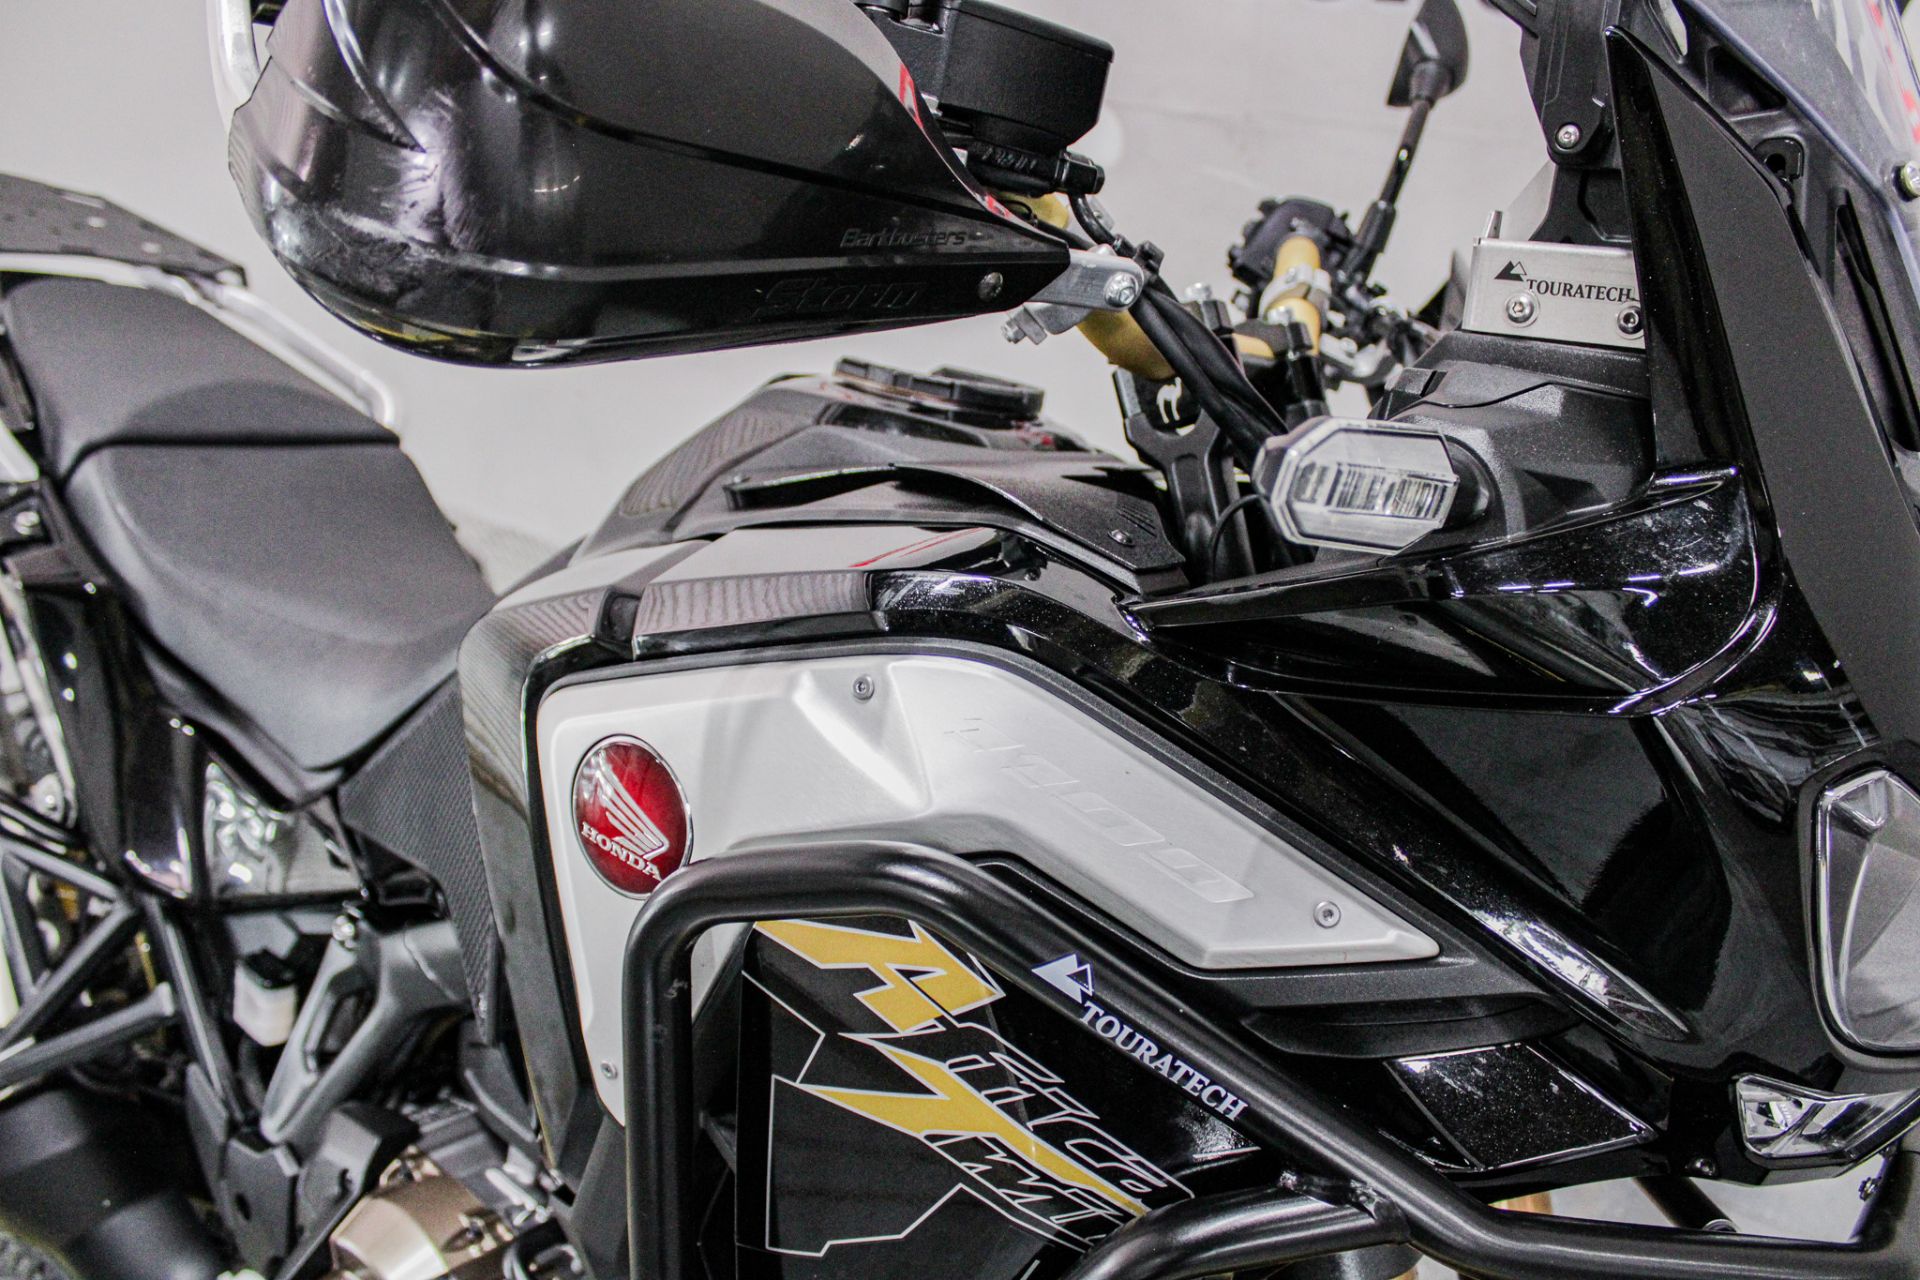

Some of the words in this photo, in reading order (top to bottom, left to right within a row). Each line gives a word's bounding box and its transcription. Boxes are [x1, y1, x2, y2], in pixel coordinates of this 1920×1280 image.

[839, 227, 967, 248] Barkbusters
[1526, 278, 1633, 302] TOURATECH
[581, 821, 663, 881] HONDA
[1080, 1001, 1248, 1121] TOURATECH
